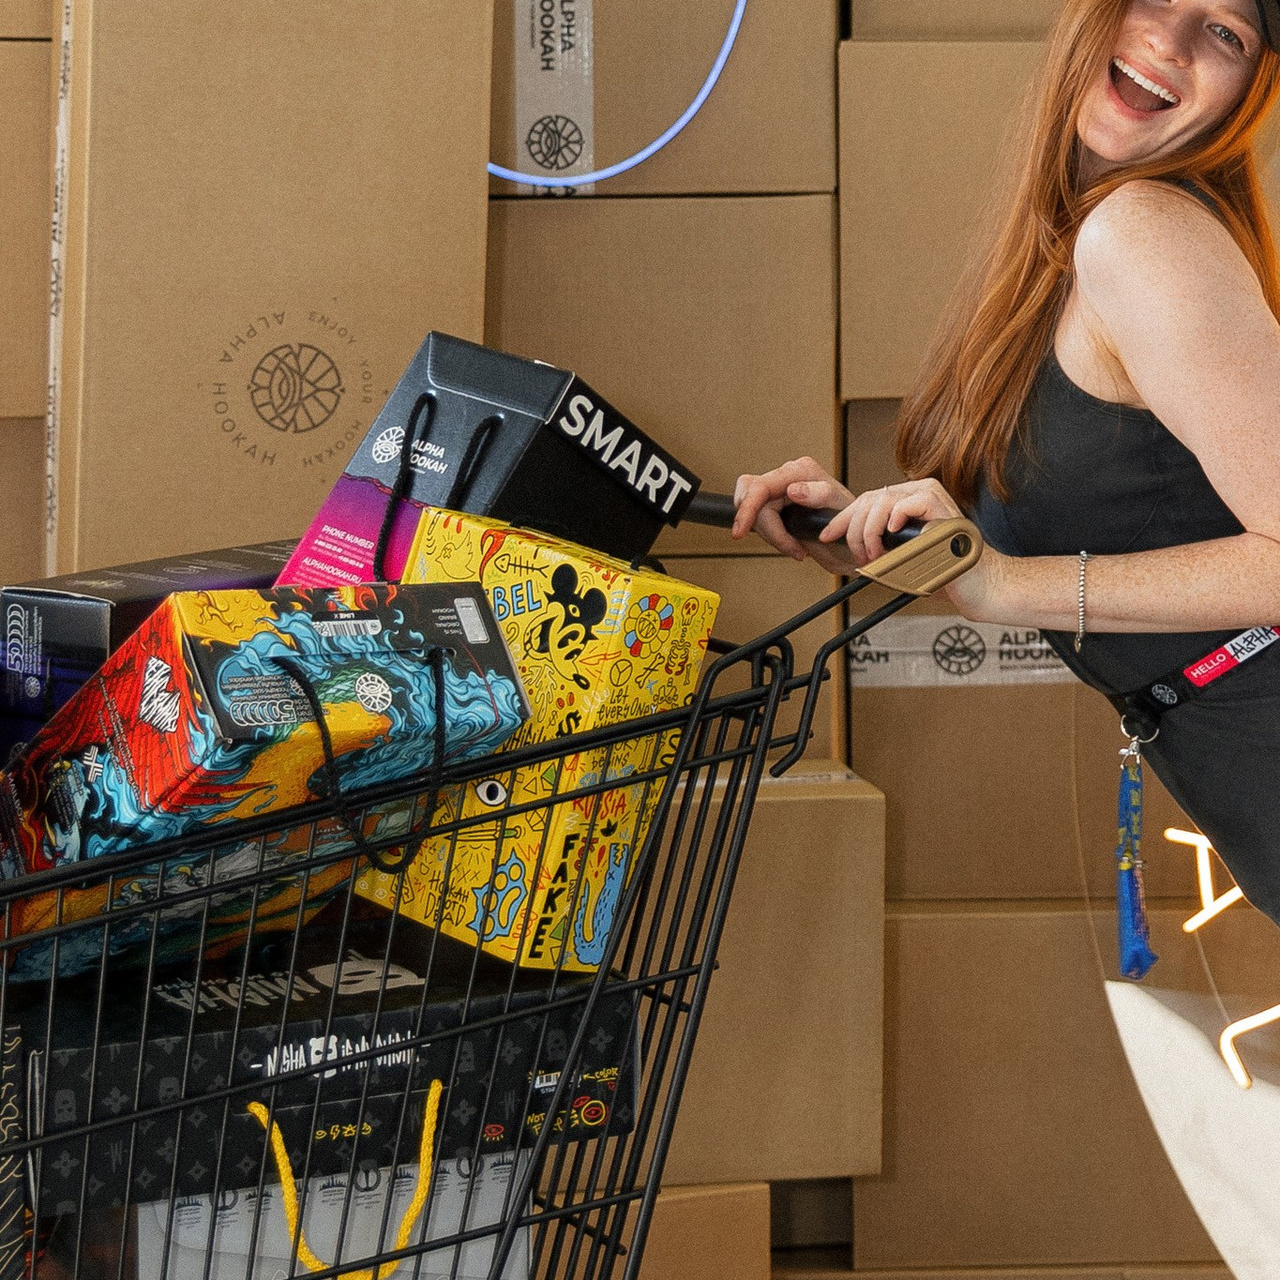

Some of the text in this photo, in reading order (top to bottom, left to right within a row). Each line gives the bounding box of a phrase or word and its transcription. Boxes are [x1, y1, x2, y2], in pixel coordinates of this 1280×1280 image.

[213, 311, 286, 466] ALPHA HOOKAH
[303, 310, 373, 468] ENJOY YOUR HOOKAH
[410, 453, 448, 474] OOKAH
[411, 439, 445, 459] ALPHA
[559, 394, 692, 514] SMART
[321, 524, 347, 540] PHONE
[345, 531, 375, 550] NUMBER
[490, 580, 542, 621] BEL
[1190, 626, 1277, 678] HELLO ALPHA
[610, 685, 630, 704] Let
[529, 833, 580, 958] FAKE
[594, 1066, 619, 1079] COLOR
[526, 1112, 546, 1124] NOT
